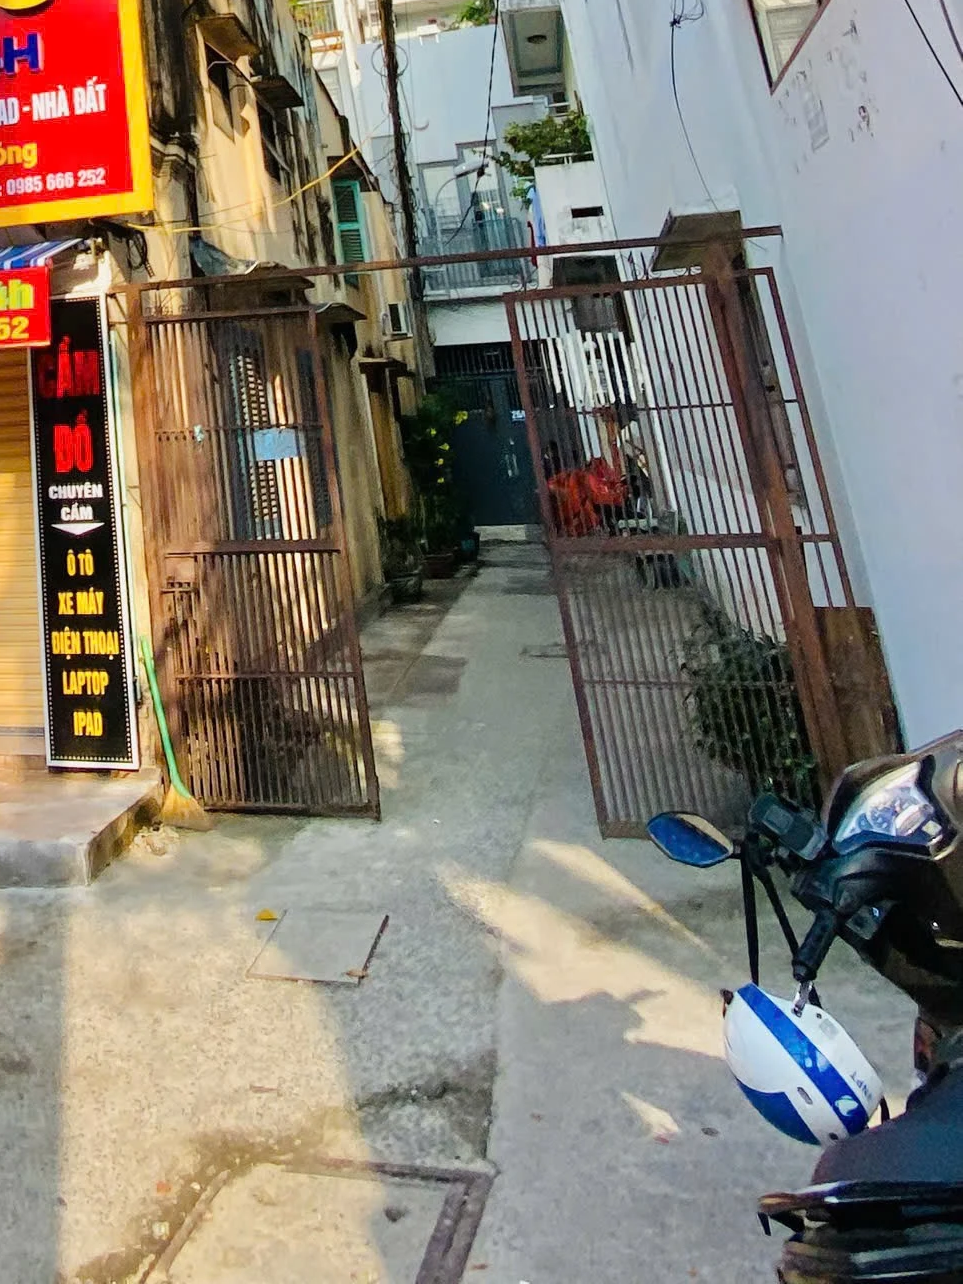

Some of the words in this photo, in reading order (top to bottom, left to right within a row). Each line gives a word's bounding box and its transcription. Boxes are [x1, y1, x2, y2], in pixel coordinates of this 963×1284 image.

[31, 84, 70, 121] NHÀ
[72, 75, 107, 115] ĐẤT
[6, 175, 43, 195] 0985
[46, 171, 74, 191] 666
[77, 167, 106, 187] 252
[48, 481, 103, 499] CHUYÊN
[66, 548, 76, 576] Ô
[77, 548, 94, 576] TÔ
[58, 592, 74, 615] XE
[76, 587, 104, 615] MÁY
[51, 626, 81, 660] ĐIỆN
[83, 630, 120, 660] THOẠI
[62, 670, 109, 695] LAPTOP
[73, 711, 103, 737] IPAD
